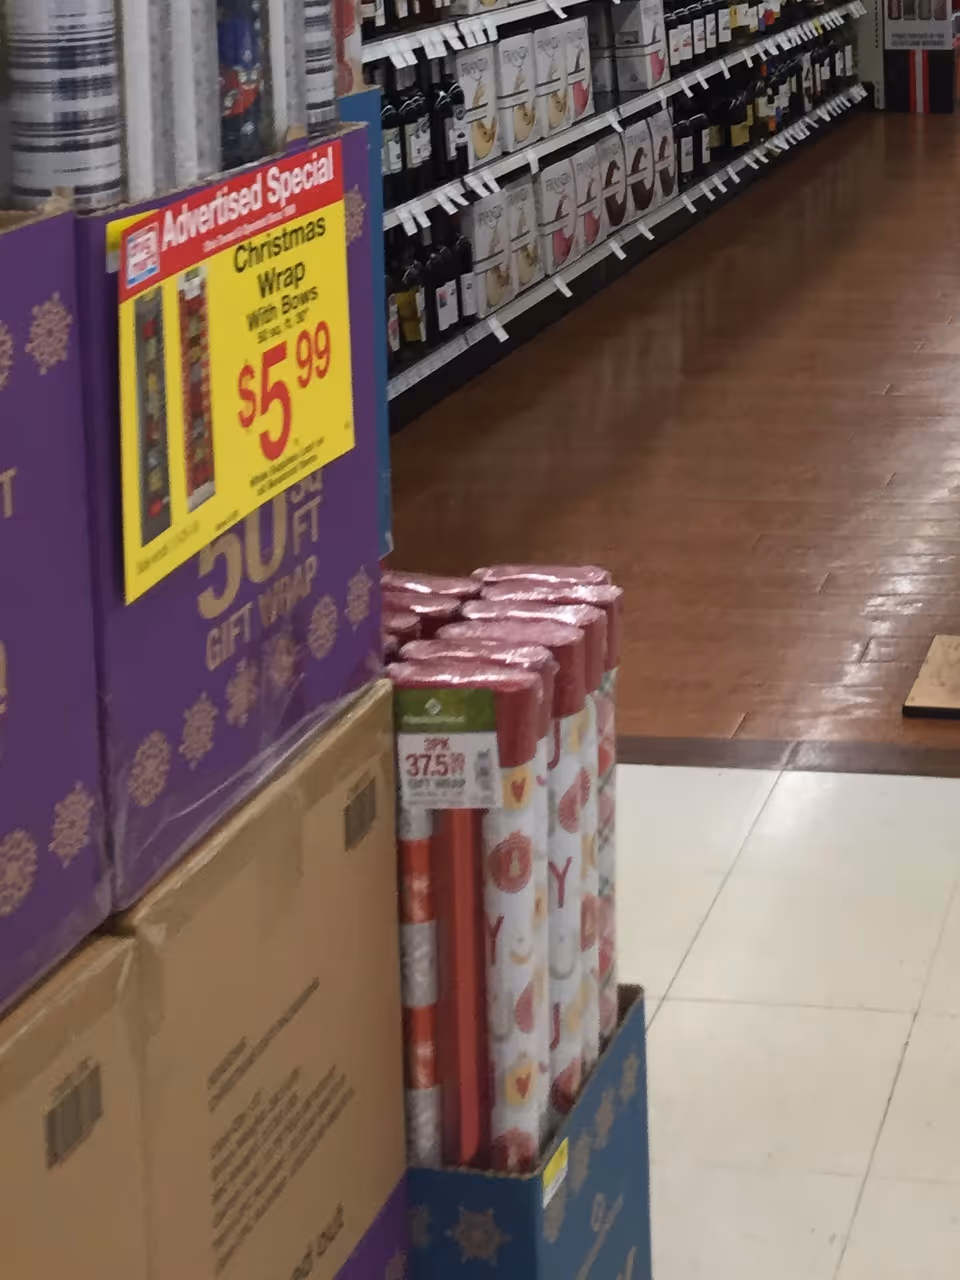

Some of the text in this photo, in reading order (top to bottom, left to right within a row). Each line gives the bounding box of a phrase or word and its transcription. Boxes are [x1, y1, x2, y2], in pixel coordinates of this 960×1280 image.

[161, 172, 263, 252] Advertised
[267, 146, 334, 207] Special
[233, 217, 326, 273] Christmas
[257, 261, 306, 299] Wrap
[281, 286, 319, 315] Bows
[293, 496, 321, 556] FT
[205, 555, 318, 672] GIFT WRAP
